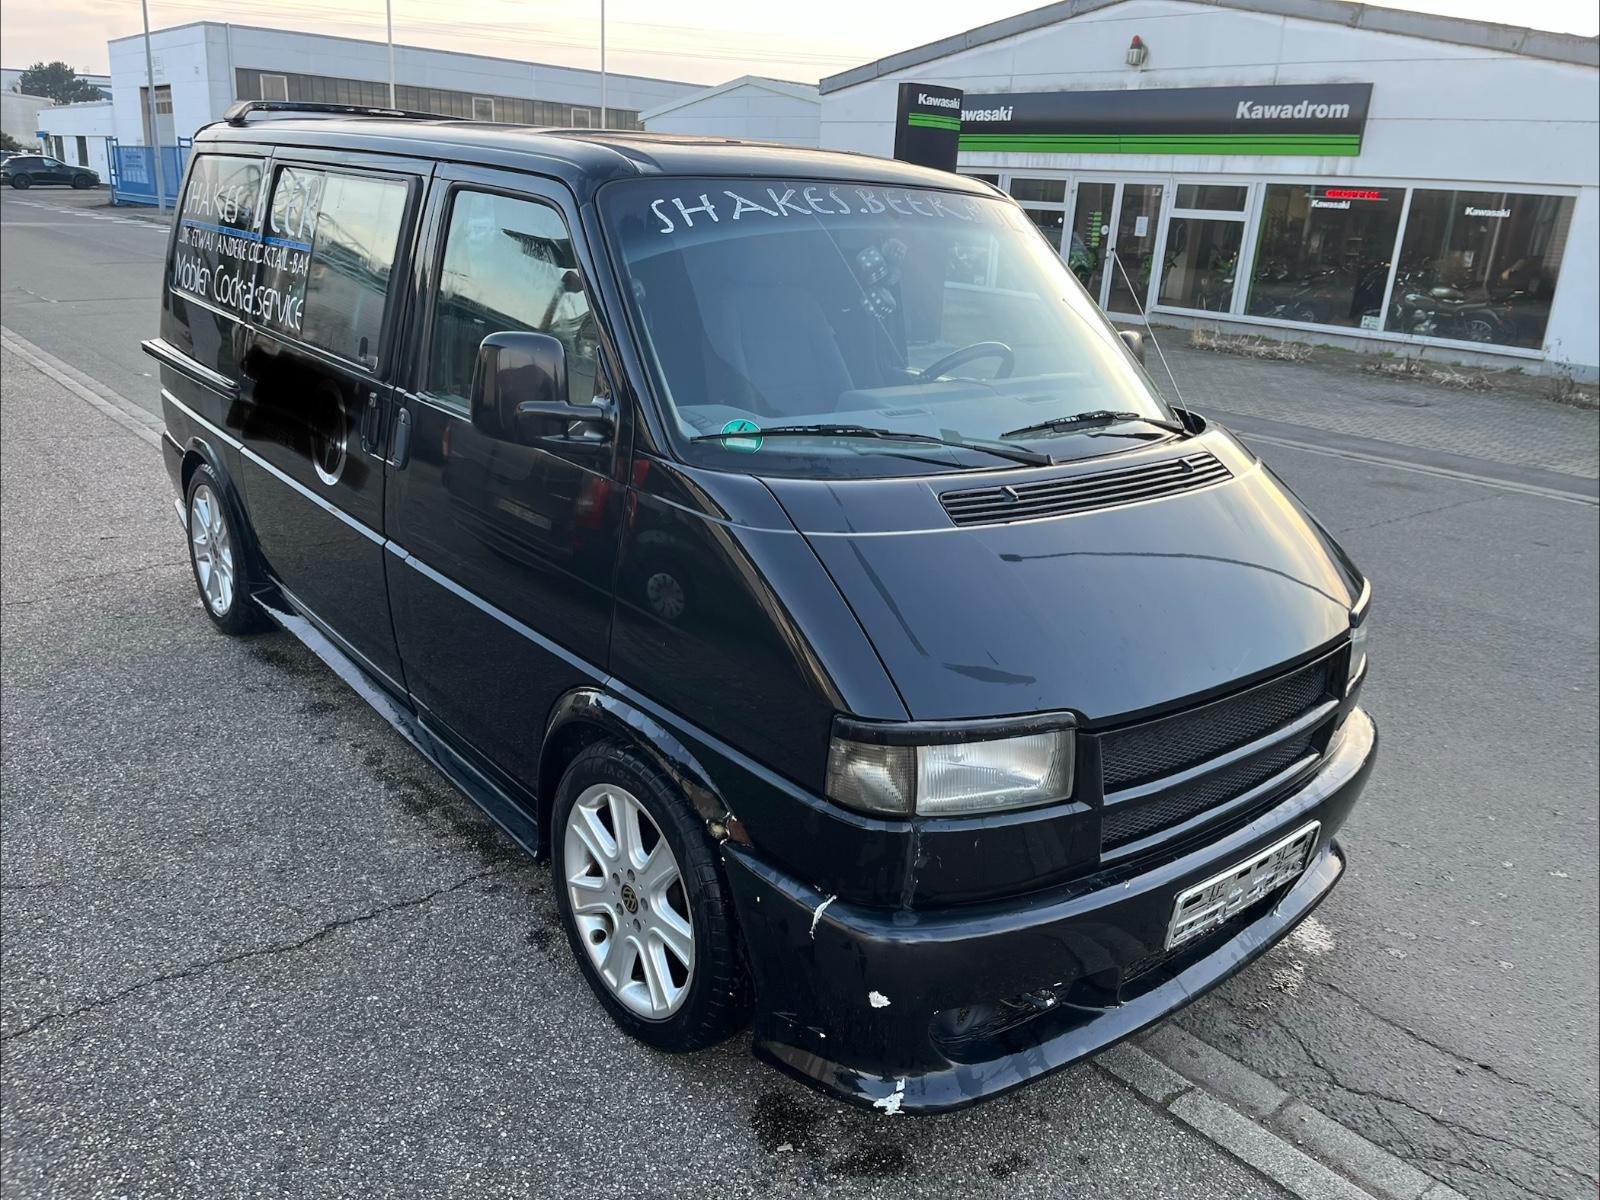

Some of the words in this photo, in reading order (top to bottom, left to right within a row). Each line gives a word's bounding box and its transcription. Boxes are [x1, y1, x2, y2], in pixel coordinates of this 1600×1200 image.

[917, 93, 961, 110] Kawasaki
[1236, 100, 1350, 119] Kawadrom
[960, 106, 1014, 122] awasaki
[183, 181, 244, 224] SHAKES
[1311, 200, 1351, 210] Kawasaki
[1464, 206, 1512, 218] Kawasaki
